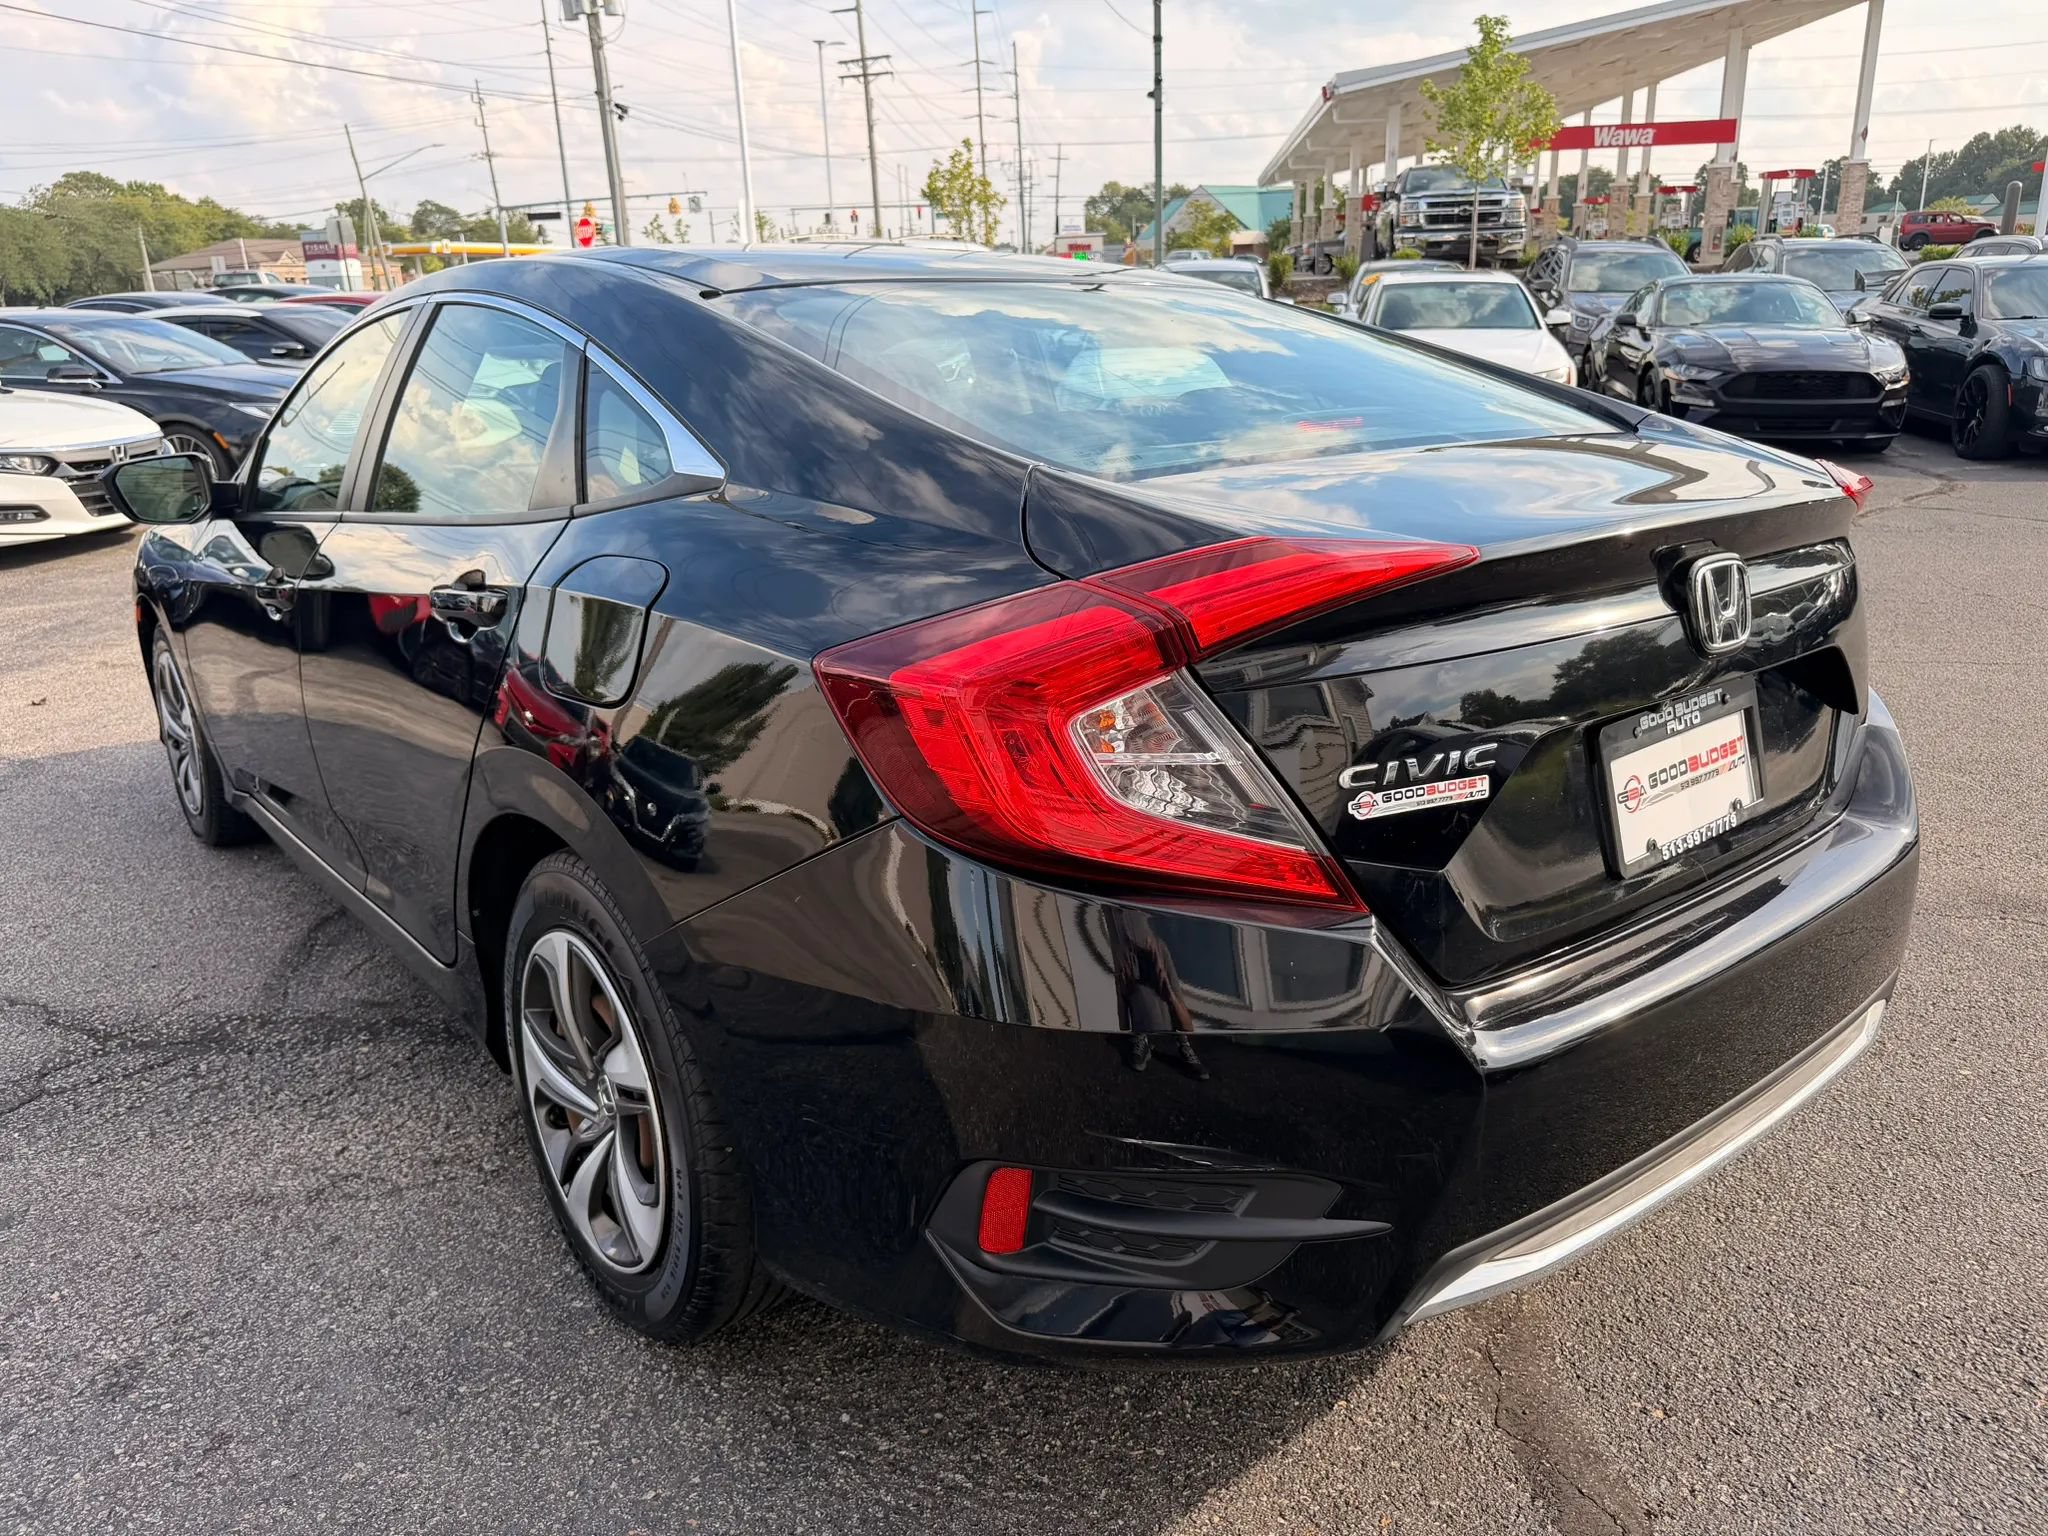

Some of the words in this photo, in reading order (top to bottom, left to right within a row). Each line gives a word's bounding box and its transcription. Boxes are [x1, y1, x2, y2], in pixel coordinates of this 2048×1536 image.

[1594, 126, 1655, 147] Wawa
[577, 225, 593, 238] STOP
[1639, 709, 1675, 730] GOOD
[1675, 687, 1723, 717] BUDGET
[1666, 710, 1701, 735] AUTO
[1338, 743, 1498, 789] CIVIC
[1464, 788, 1487, 799] AUTO
